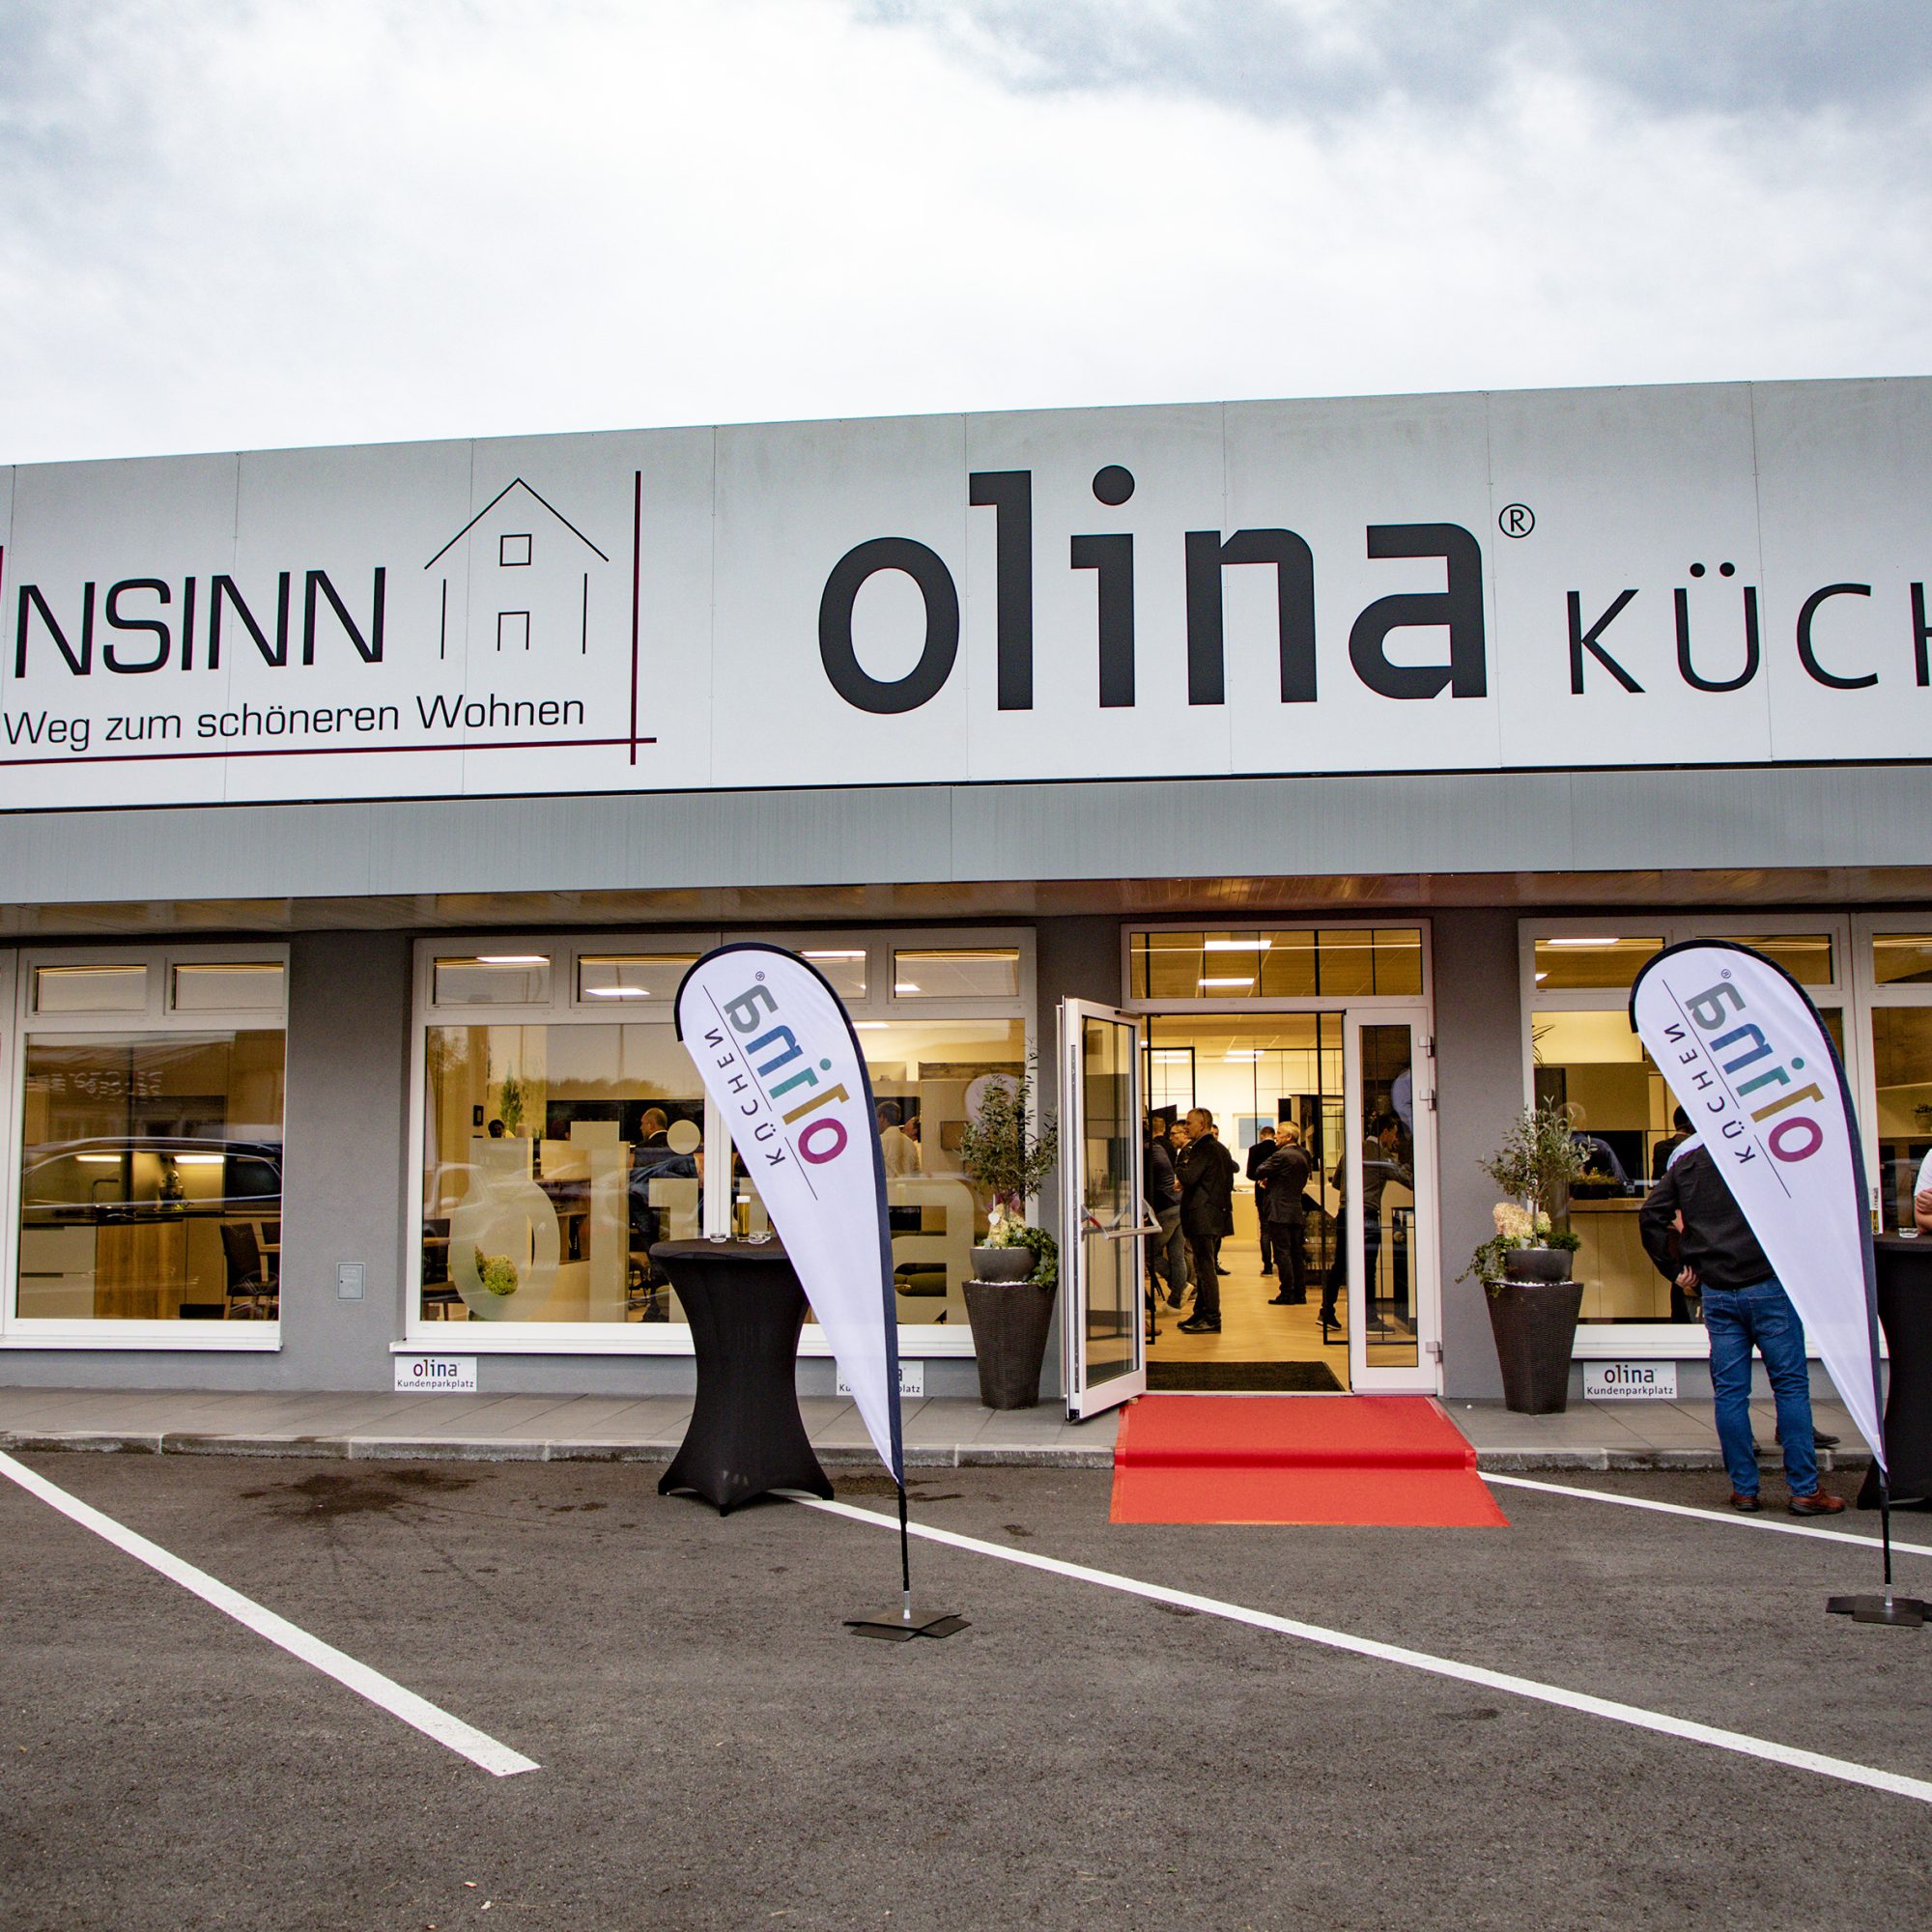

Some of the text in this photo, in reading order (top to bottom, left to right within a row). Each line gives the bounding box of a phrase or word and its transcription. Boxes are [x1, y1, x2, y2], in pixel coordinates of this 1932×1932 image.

[14, 566, 386, 679] NSINN
[3, 693, 584, 753] Weg zum schöneren Wohnen
[413, 1359, 458, 1377] olina
[1605, 1364, 1655, 1383] olina
[397, 1379, 474, 1389] Kundenparkplatz
[1587, 1386, 1673, 1397] Kundenparkplatz
